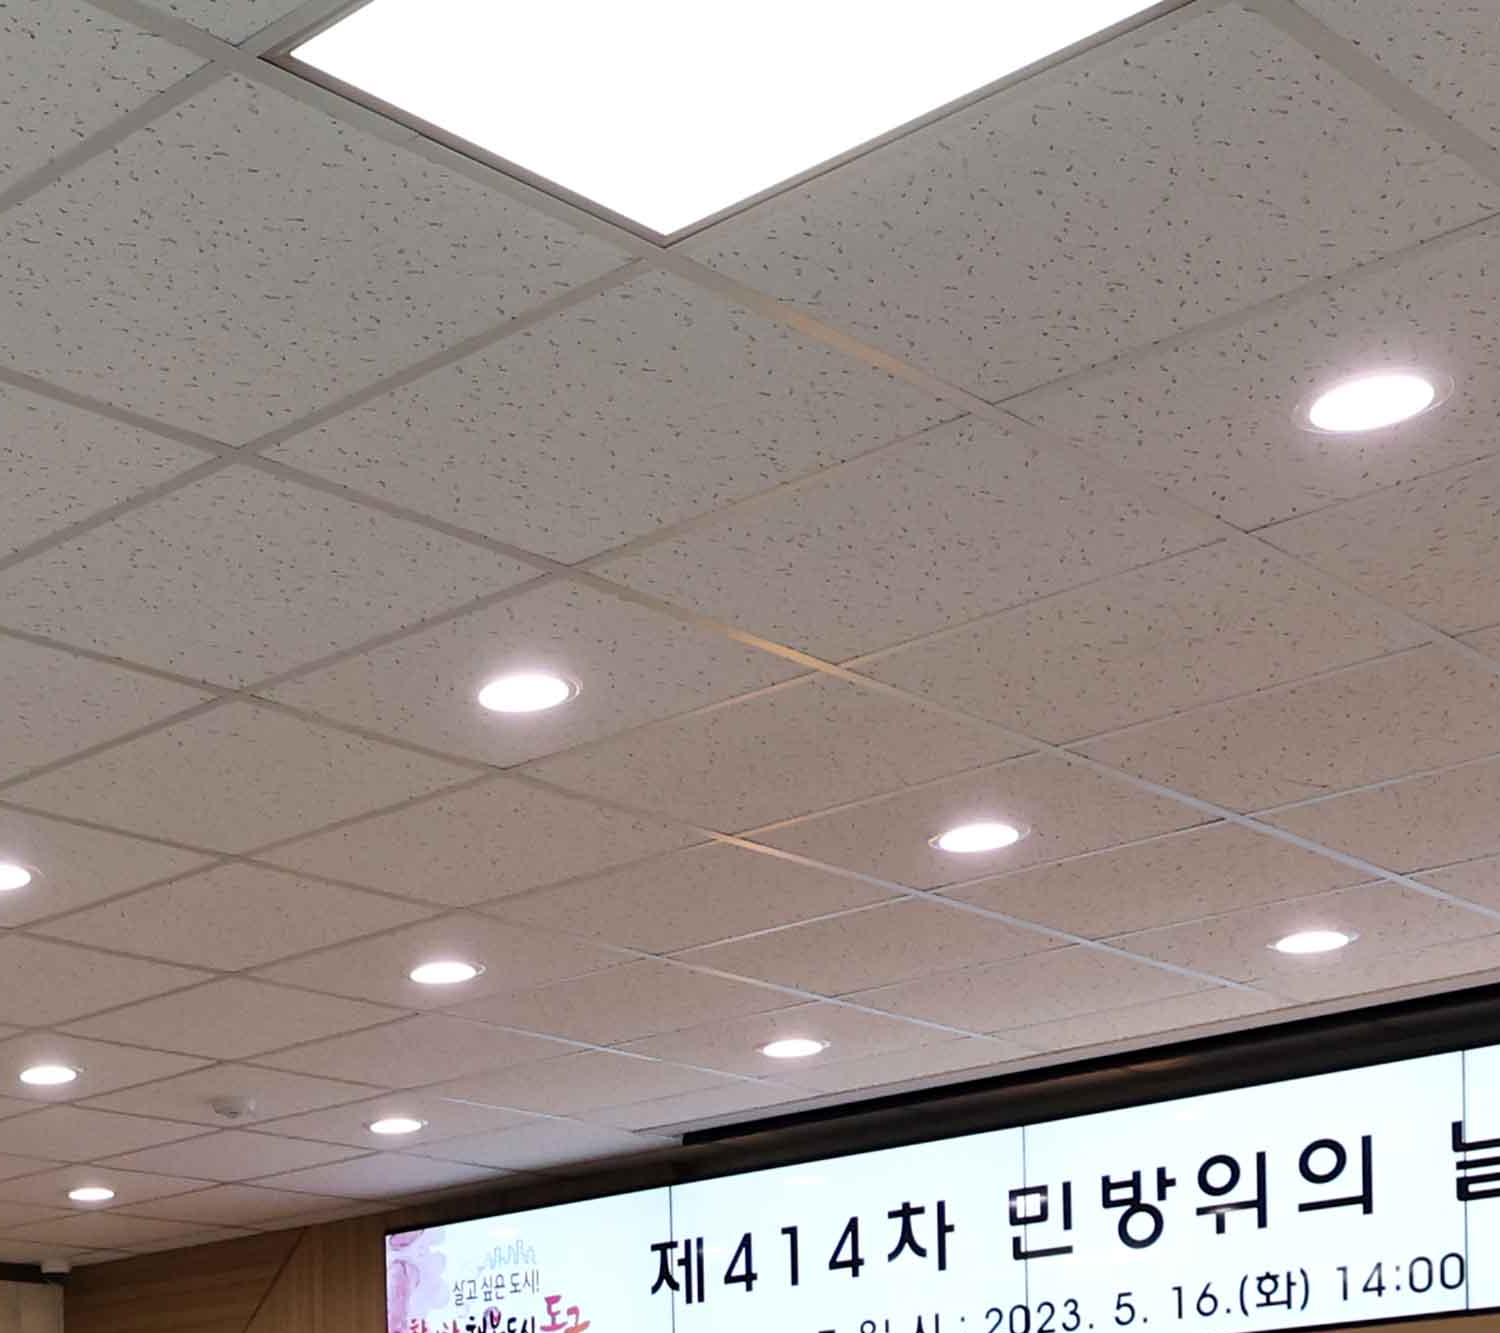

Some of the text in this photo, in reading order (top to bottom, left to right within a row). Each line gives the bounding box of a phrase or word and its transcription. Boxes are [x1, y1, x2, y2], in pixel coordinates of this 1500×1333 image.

[649, 1200, 957, 1305] 제414차
[1008, 1134, 1374, 1262] 민방위의
[1114, 1290, 1149, 1326] 5.
[1171, 1267, 1311, 1321] 16.(화)
[1336, 1252, 1467, 1302] 14:00
